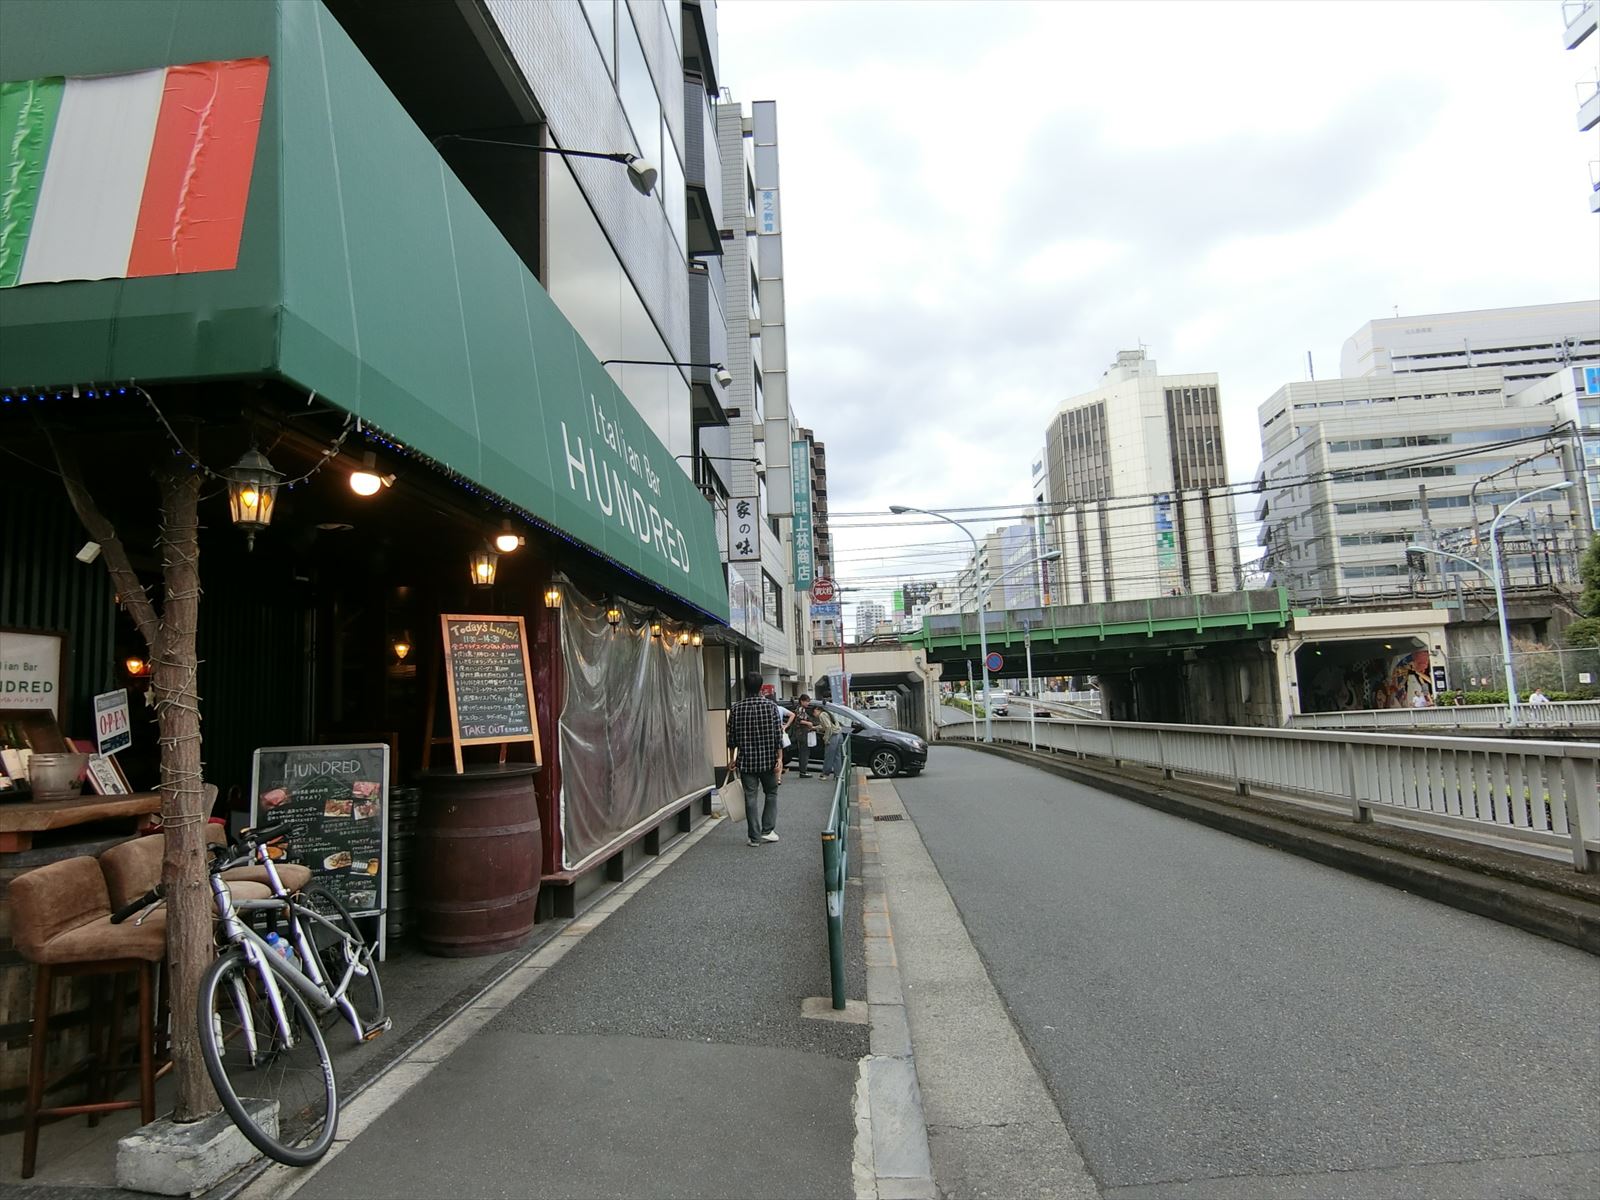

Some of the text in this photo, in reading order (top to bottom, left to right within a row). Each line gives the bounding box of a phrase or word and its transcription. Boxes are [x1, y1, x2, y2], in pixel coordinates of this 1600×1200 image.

[590, 393, 662, 498] Italian Bar
[561, 421, 691, 573] HUNDRED
[735, 499, 754, 555] 家の味
[795, 515, 811, 581] 上林商店
[450, 622, 519, 642] Today's Lunch
[23, 662, 38, 671] Bar
[462, 725, 486, 737] TAKE
[488, 725, 505, 734] OUT
[284, 759, 361, 779] HUNDRED
